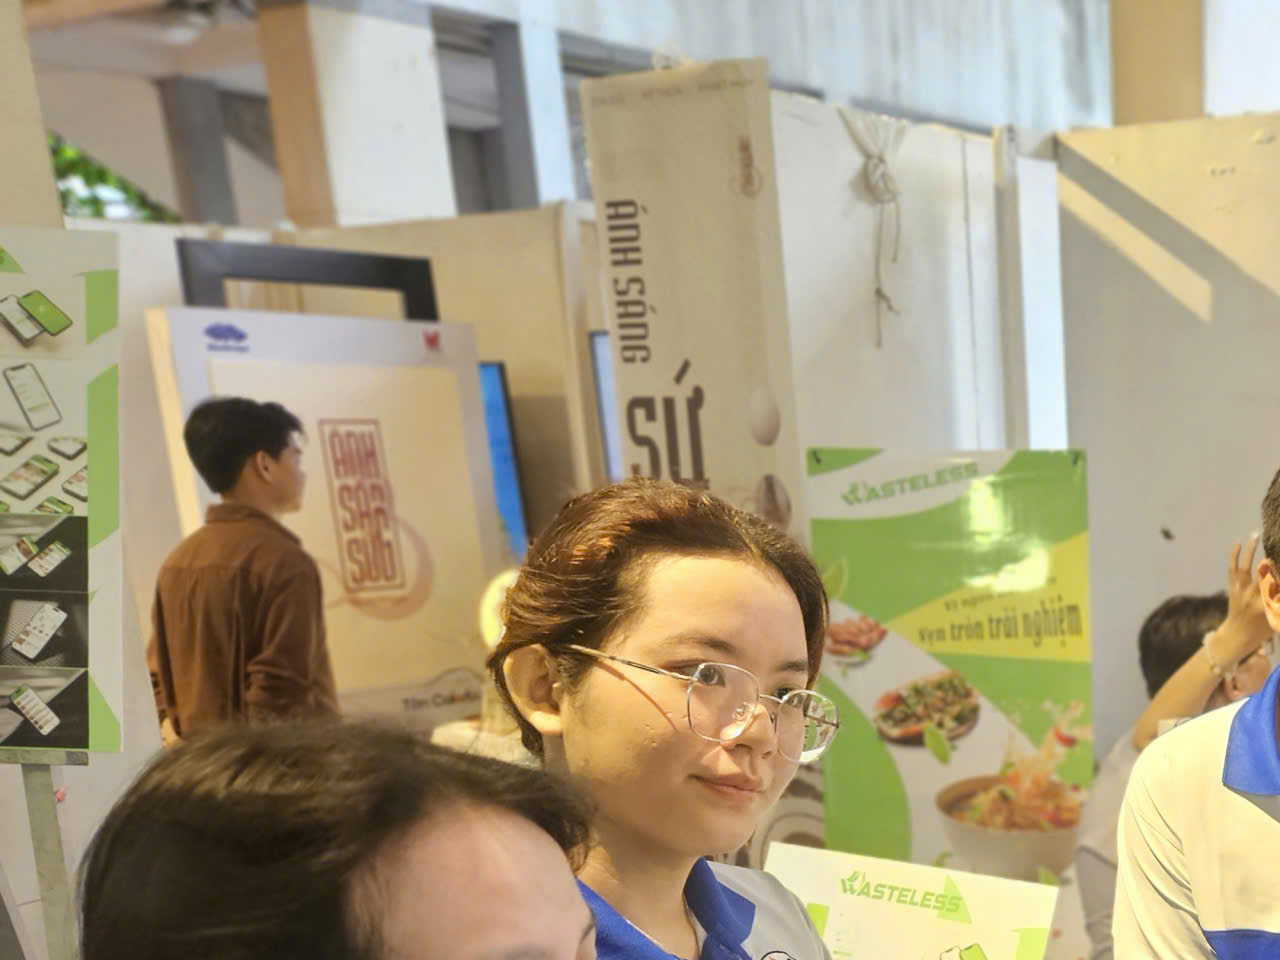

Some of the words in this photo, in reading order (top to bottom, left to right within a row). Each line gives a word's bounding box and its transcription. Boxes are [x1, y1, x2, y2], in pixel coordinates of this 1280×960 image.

[605, 199, 649, 267] ÁNH
[613, 276, 658, 364] SÁNG
[625, 357, 710, 491] SỨ
[840, 870, 963, 913] WASTELESS
